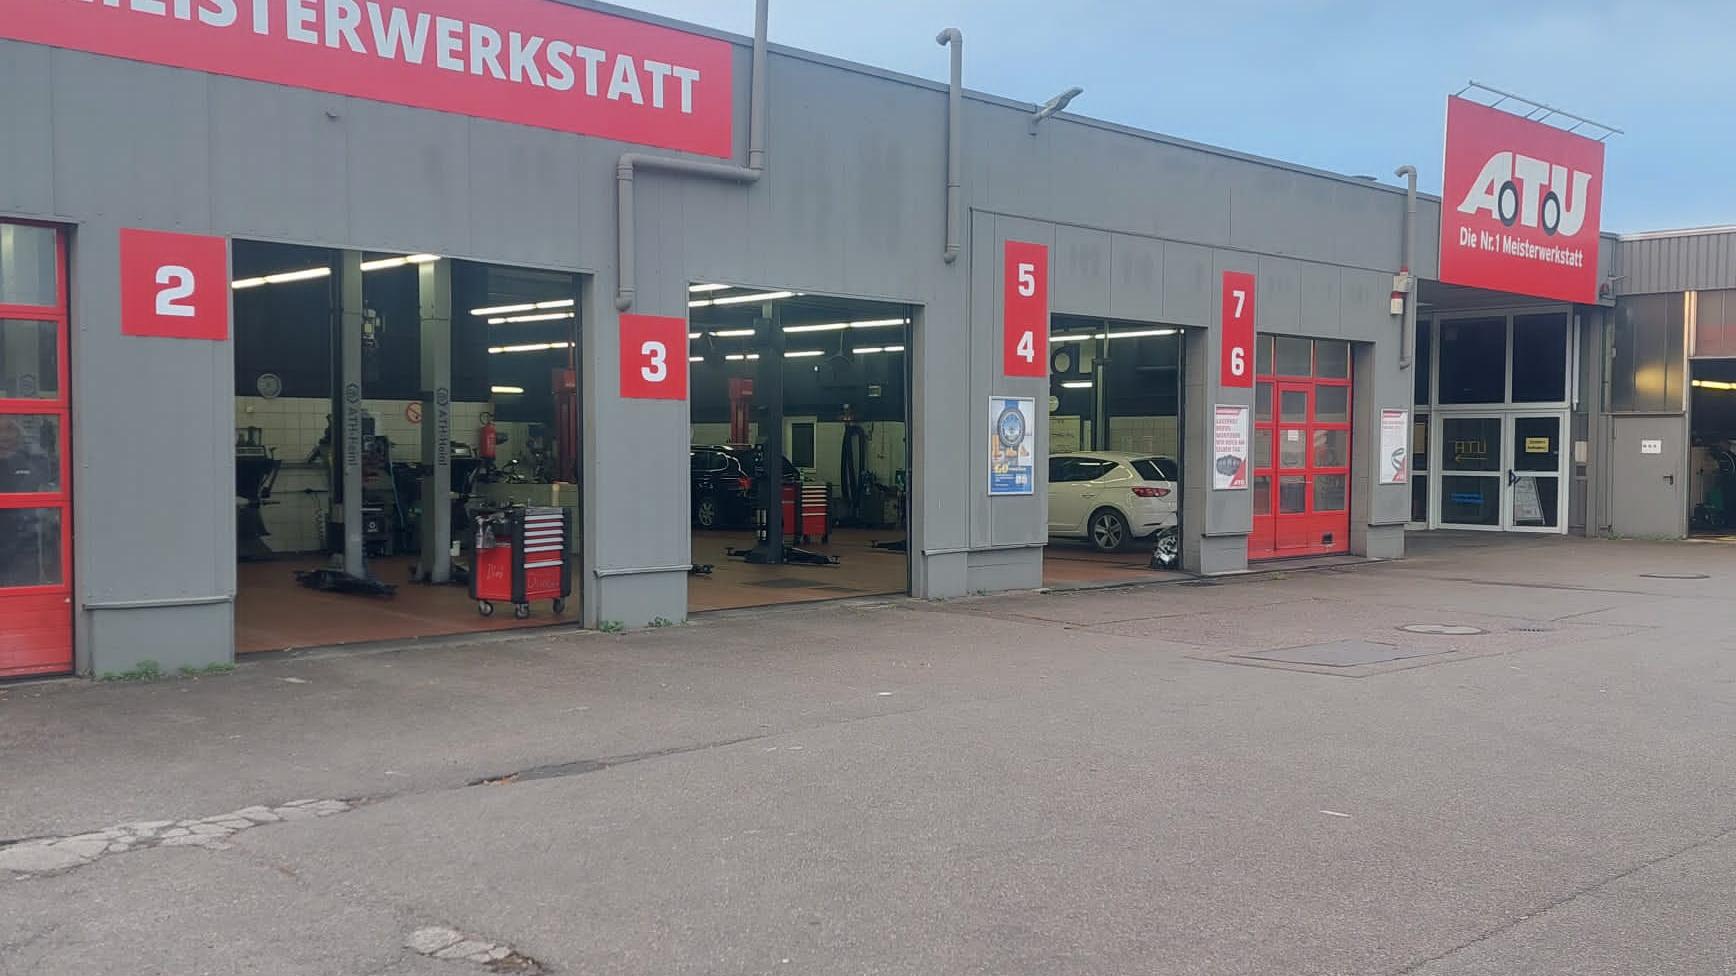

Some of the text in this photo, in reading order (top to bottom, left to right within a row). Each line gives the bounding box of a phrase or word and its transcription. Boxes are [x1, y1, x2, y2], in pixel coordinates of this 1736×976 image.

[1457, 151, 1593, 237] ATU
[1459, 226, 1477, 249] Die
[1502, 235, 1584, 268] Meisterwerkstatt
[155, 265, 196, 317] 2
[1018, 263, 1035, 297] 5
[1232, 290, 1246, 319] 7
[641, 341, 667, 382] 3
[1016, 330, 1035, 363] 4
[1231, 346, 1245, 376] 6
